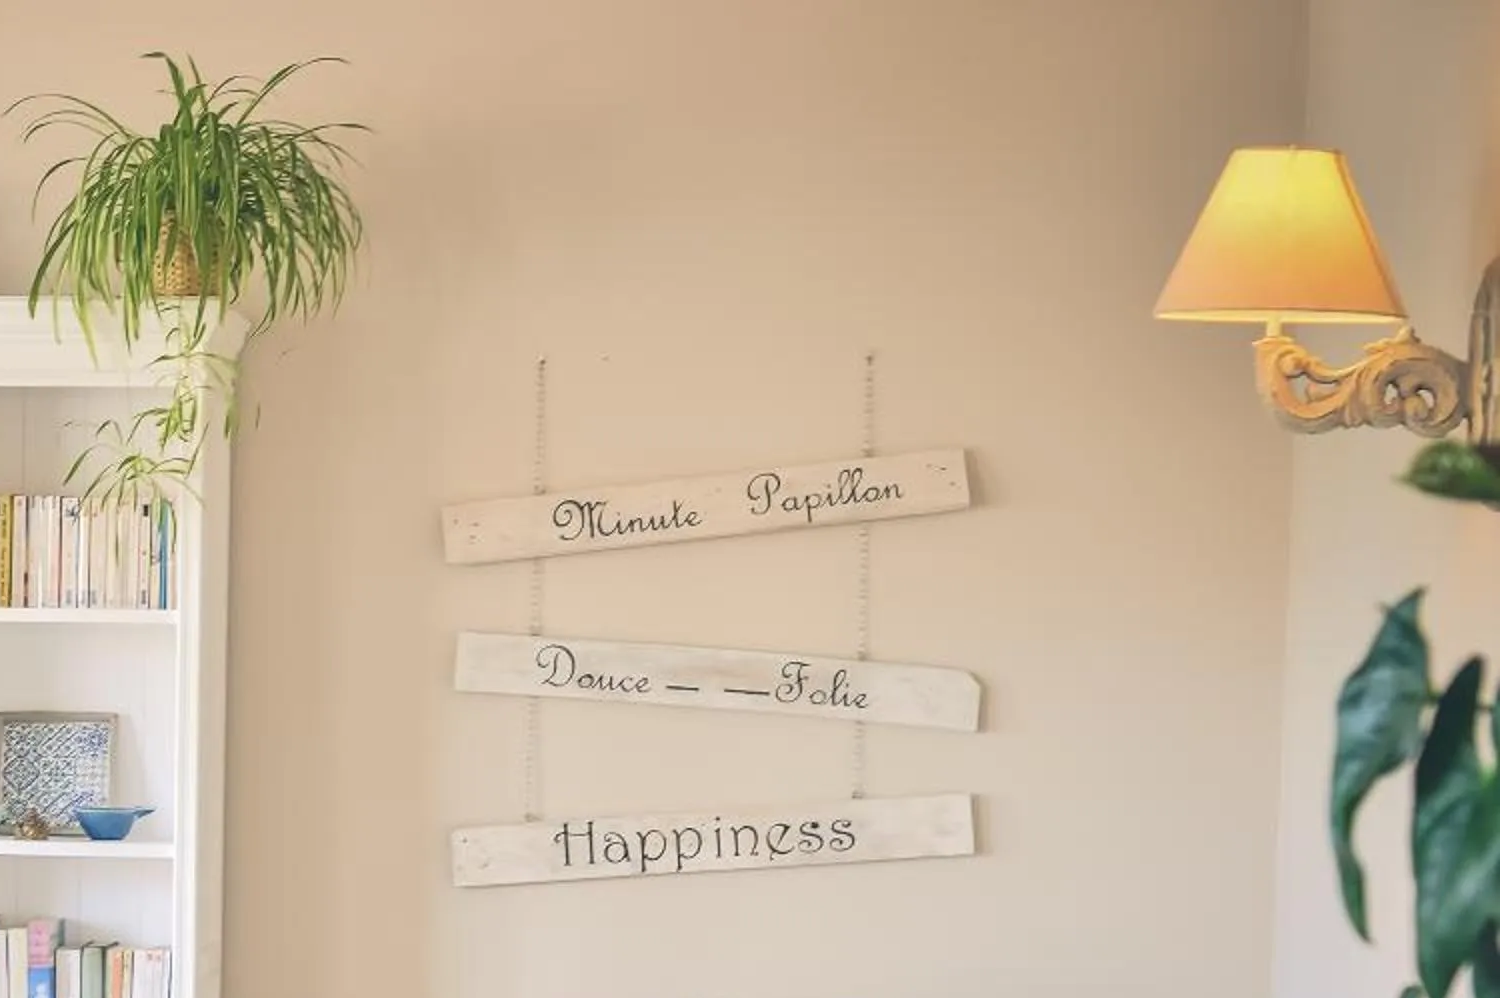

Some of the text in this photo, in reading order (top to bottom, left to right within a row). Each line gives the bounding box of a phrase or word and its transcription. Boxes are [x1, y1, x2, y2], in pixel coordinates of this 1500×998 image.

[551, 468, 904, 542] Minute Papillon
[534, 643, 870, 710] Douce Folie
[553, 816, 855, 873] Happiness
